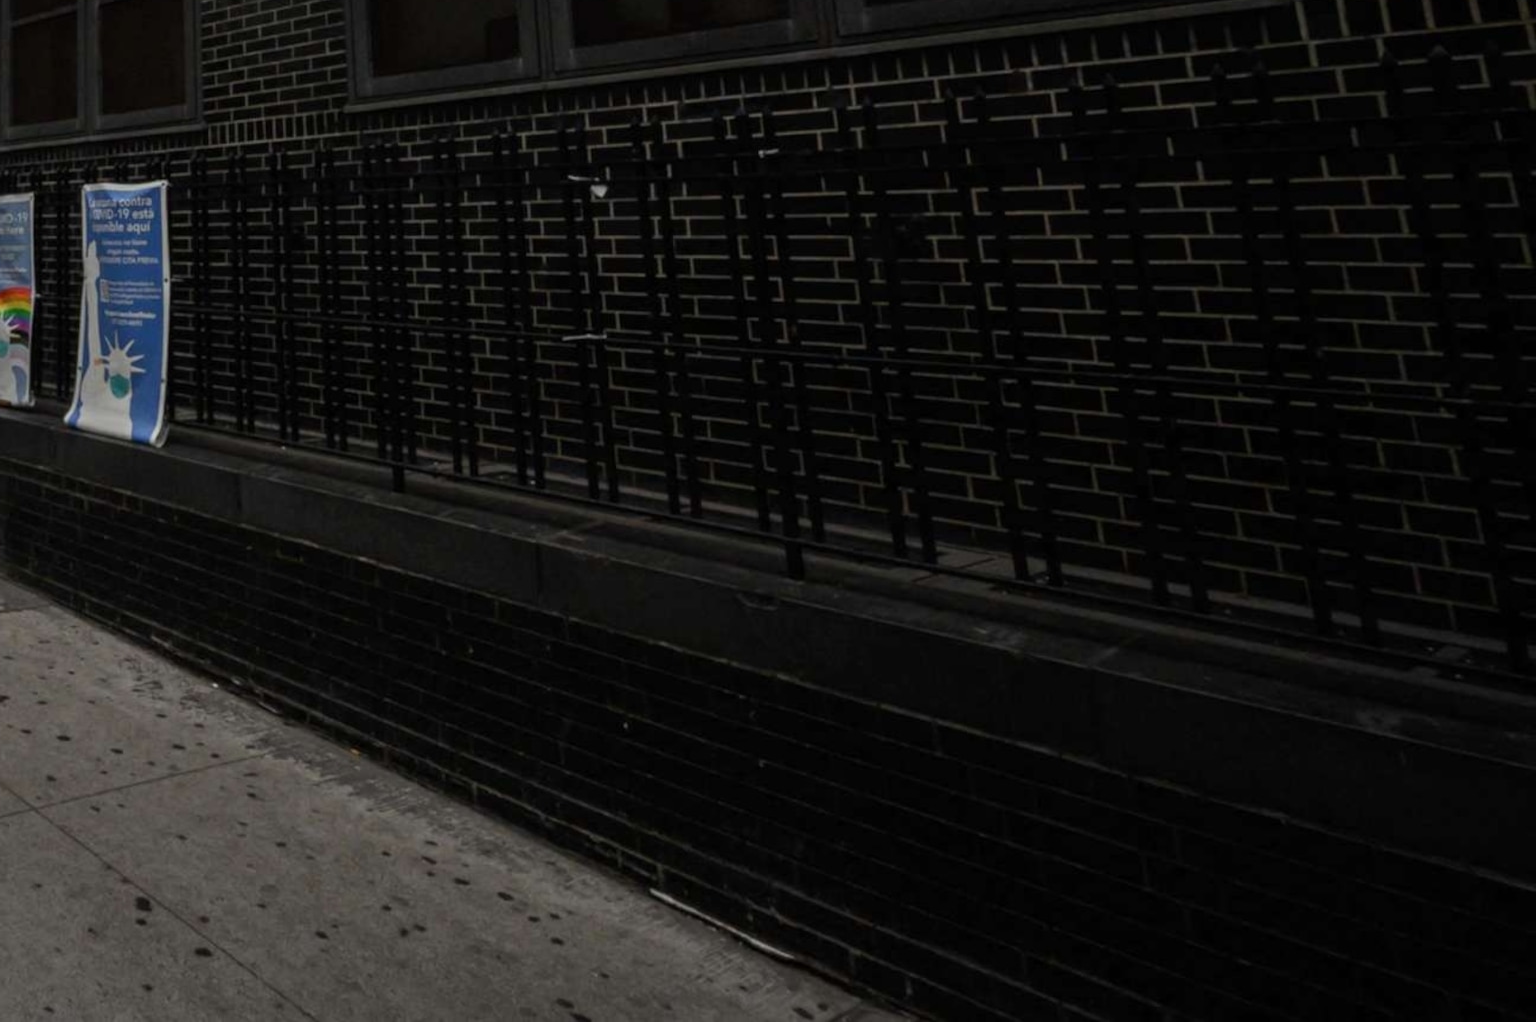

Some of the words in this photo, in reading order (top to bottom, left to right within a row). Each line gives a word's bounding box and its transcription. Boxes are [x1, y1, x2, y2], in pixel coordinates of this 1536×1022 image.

[118, 196, 153, 207] contra
[131, 207, 155, 219] está
[126, 221, 152, 235] aquí
